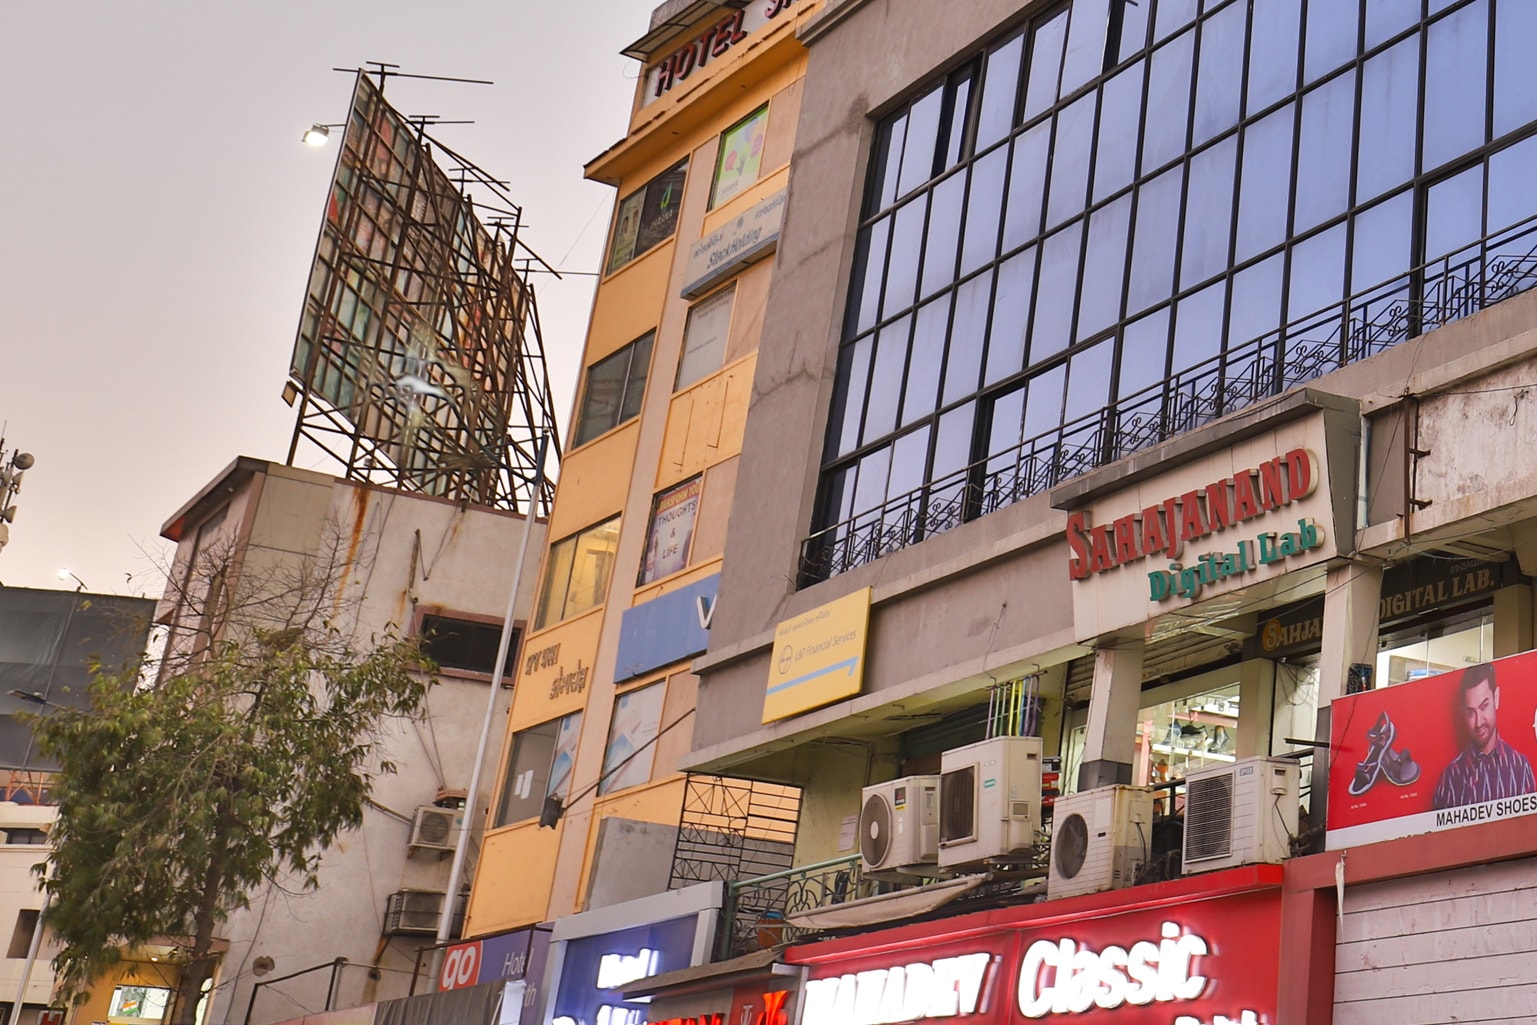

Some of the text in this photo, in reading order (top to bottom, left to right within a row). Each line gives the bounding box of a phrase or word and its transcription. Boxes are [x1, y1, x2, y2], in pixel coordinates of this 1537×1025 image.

[654, 10, 747, 97] HOTEL
[658, 500, 697, 527] THOUGHTS
[1066, 448, 1318, 581] SAHAJANAND
[662, 543, 678, 559] LIFE
[1149, 518, 1325, 602] Digital Lab
[1265, 568, 1494, 649] SAHJA DIGITAL LAB.
[806, 638, 832, 657] Financial
[832, 630, 857, 647] Services
[1436, 796, 1537, 827] MAHADEV SHOES
[443, 944, 477, 989] go
[1018, 921, 1209, 1018] Classic
